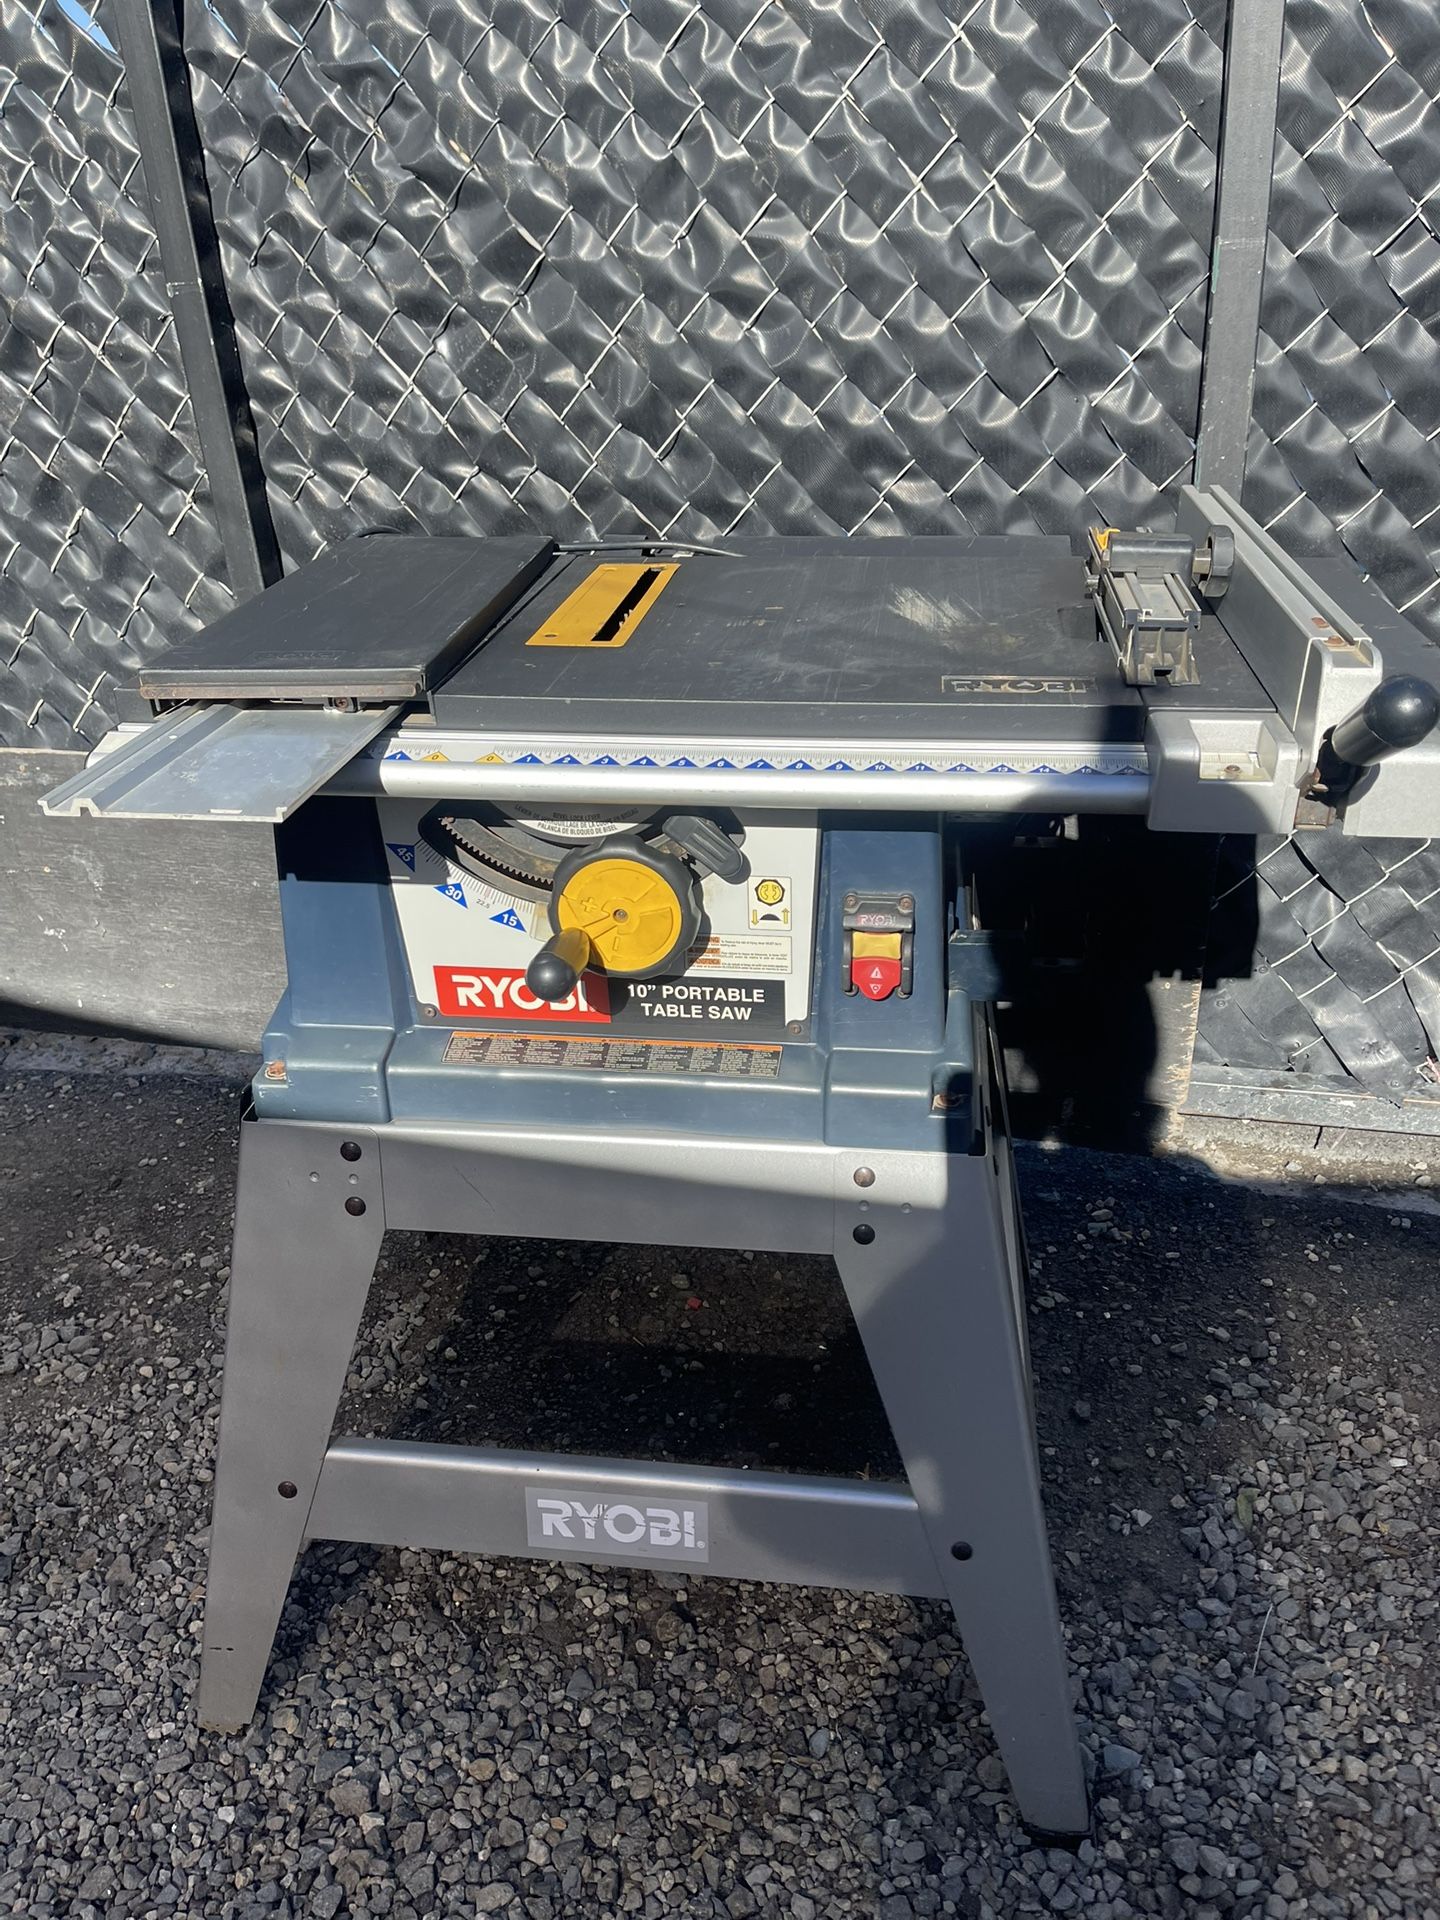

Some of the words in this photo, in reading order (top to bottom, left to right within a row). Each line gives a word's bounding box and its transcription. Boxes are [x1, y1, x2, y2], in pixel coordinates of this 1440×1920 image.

[595, 827, 604, 835] DE
[604, 824, 617, 834] BISEL
[396, 846, 414, 862] 45
[444, 885, 463, 901] 30
[502, 914, 518, 927] 15
[663, 985, 765, 1003] PORTABLE
[641, 1003, 703, 1019] TABLE
[708, 1006, 752, 1021] SAW
